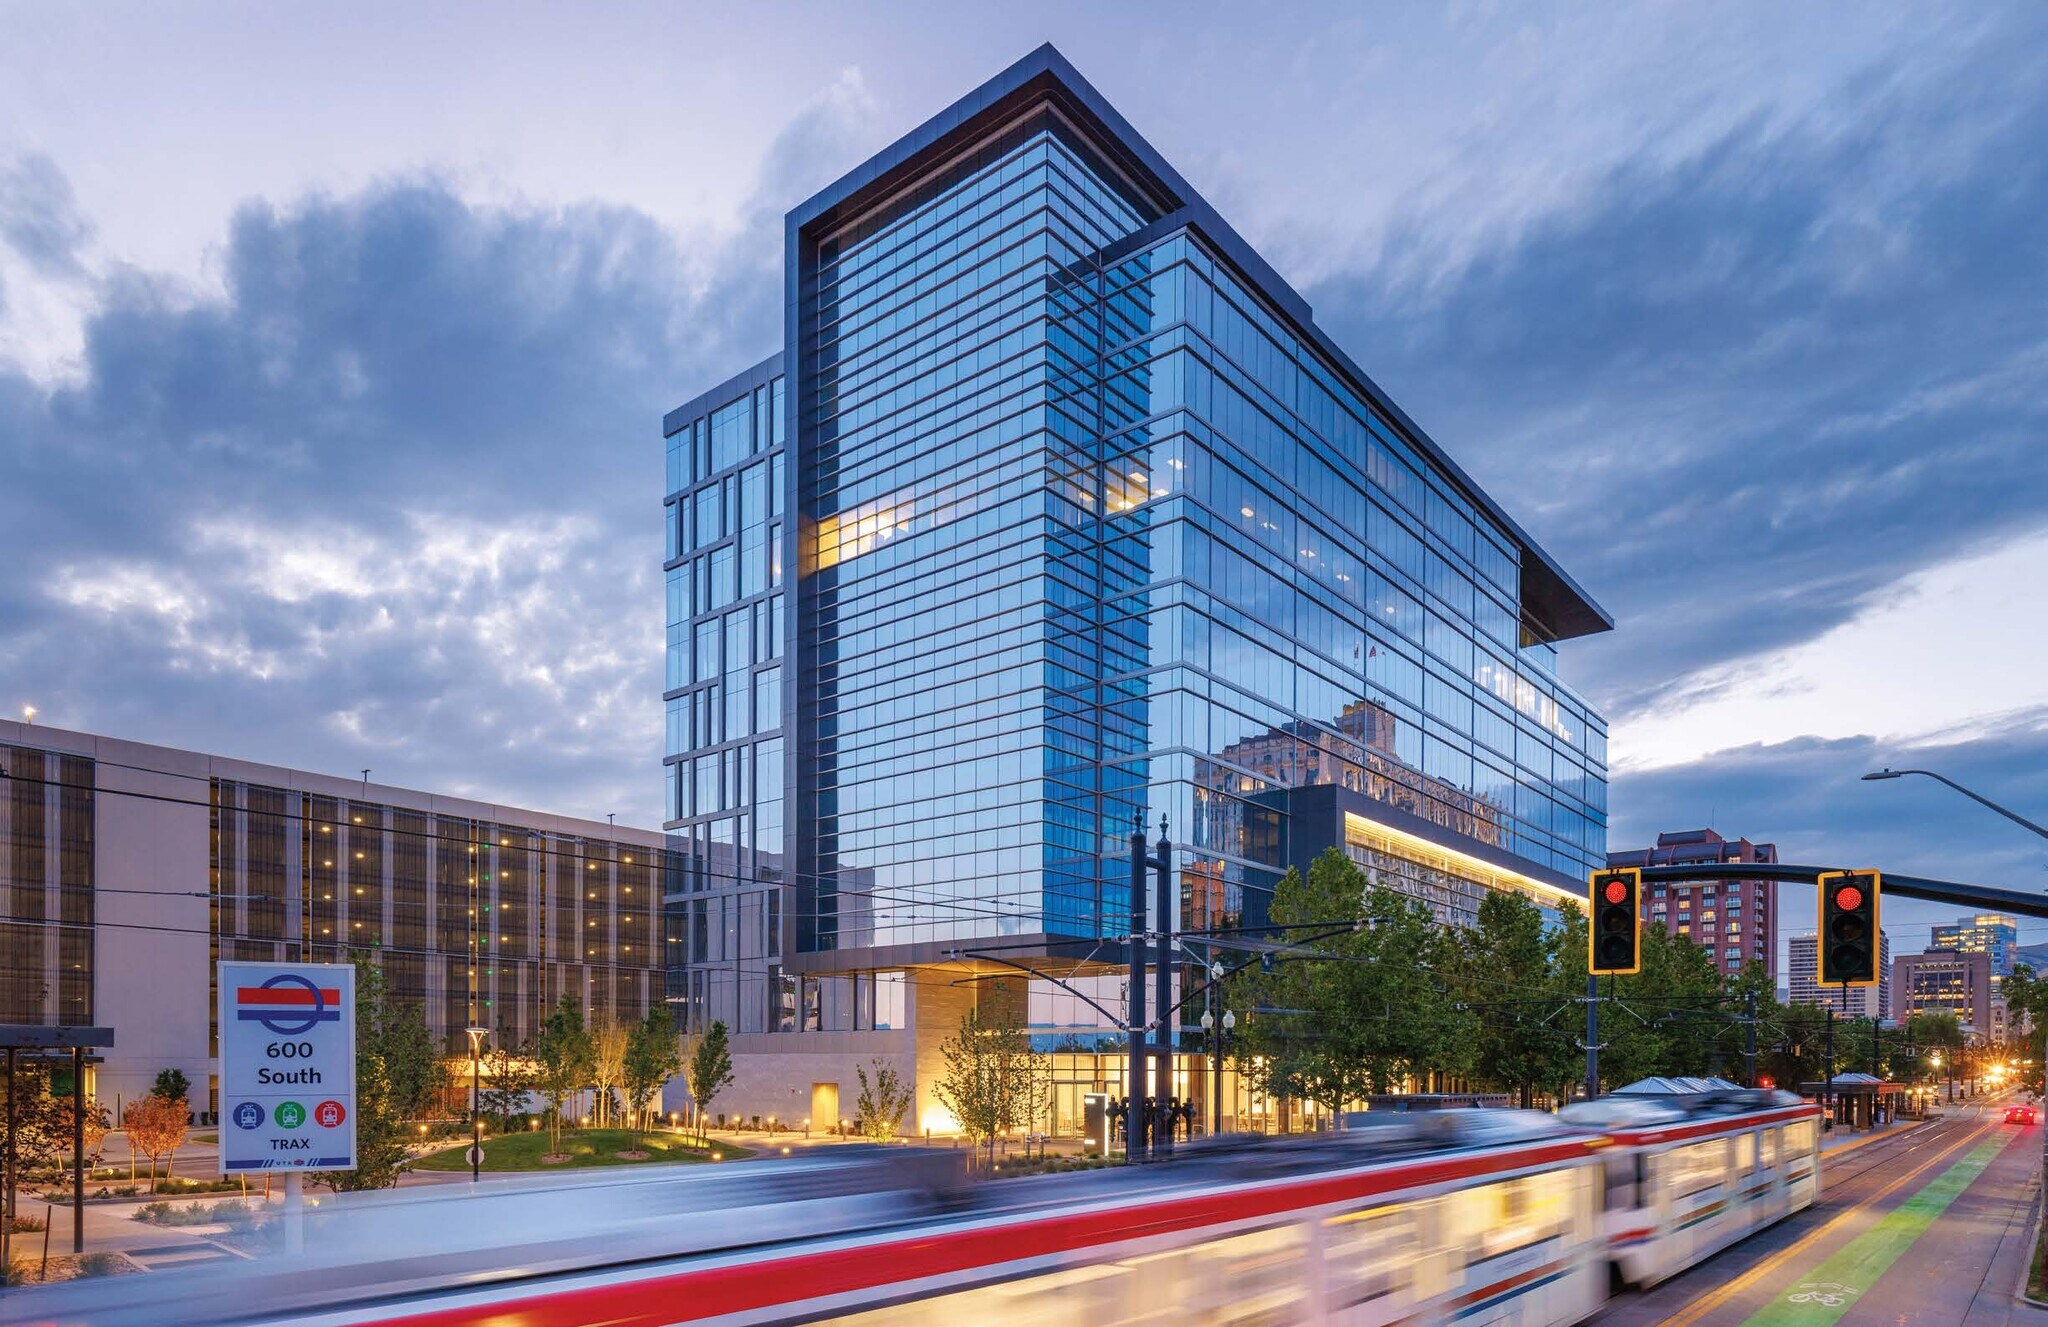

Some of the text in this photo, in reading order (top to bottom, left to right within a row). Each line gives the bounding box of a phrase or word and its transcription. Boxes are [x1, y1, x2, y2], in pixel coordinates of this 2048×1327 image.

[266, 1042, 313, 1058] 600
[258, 1067, 322, 1084] South
[270, 1138, 310, 1150] TRAX
